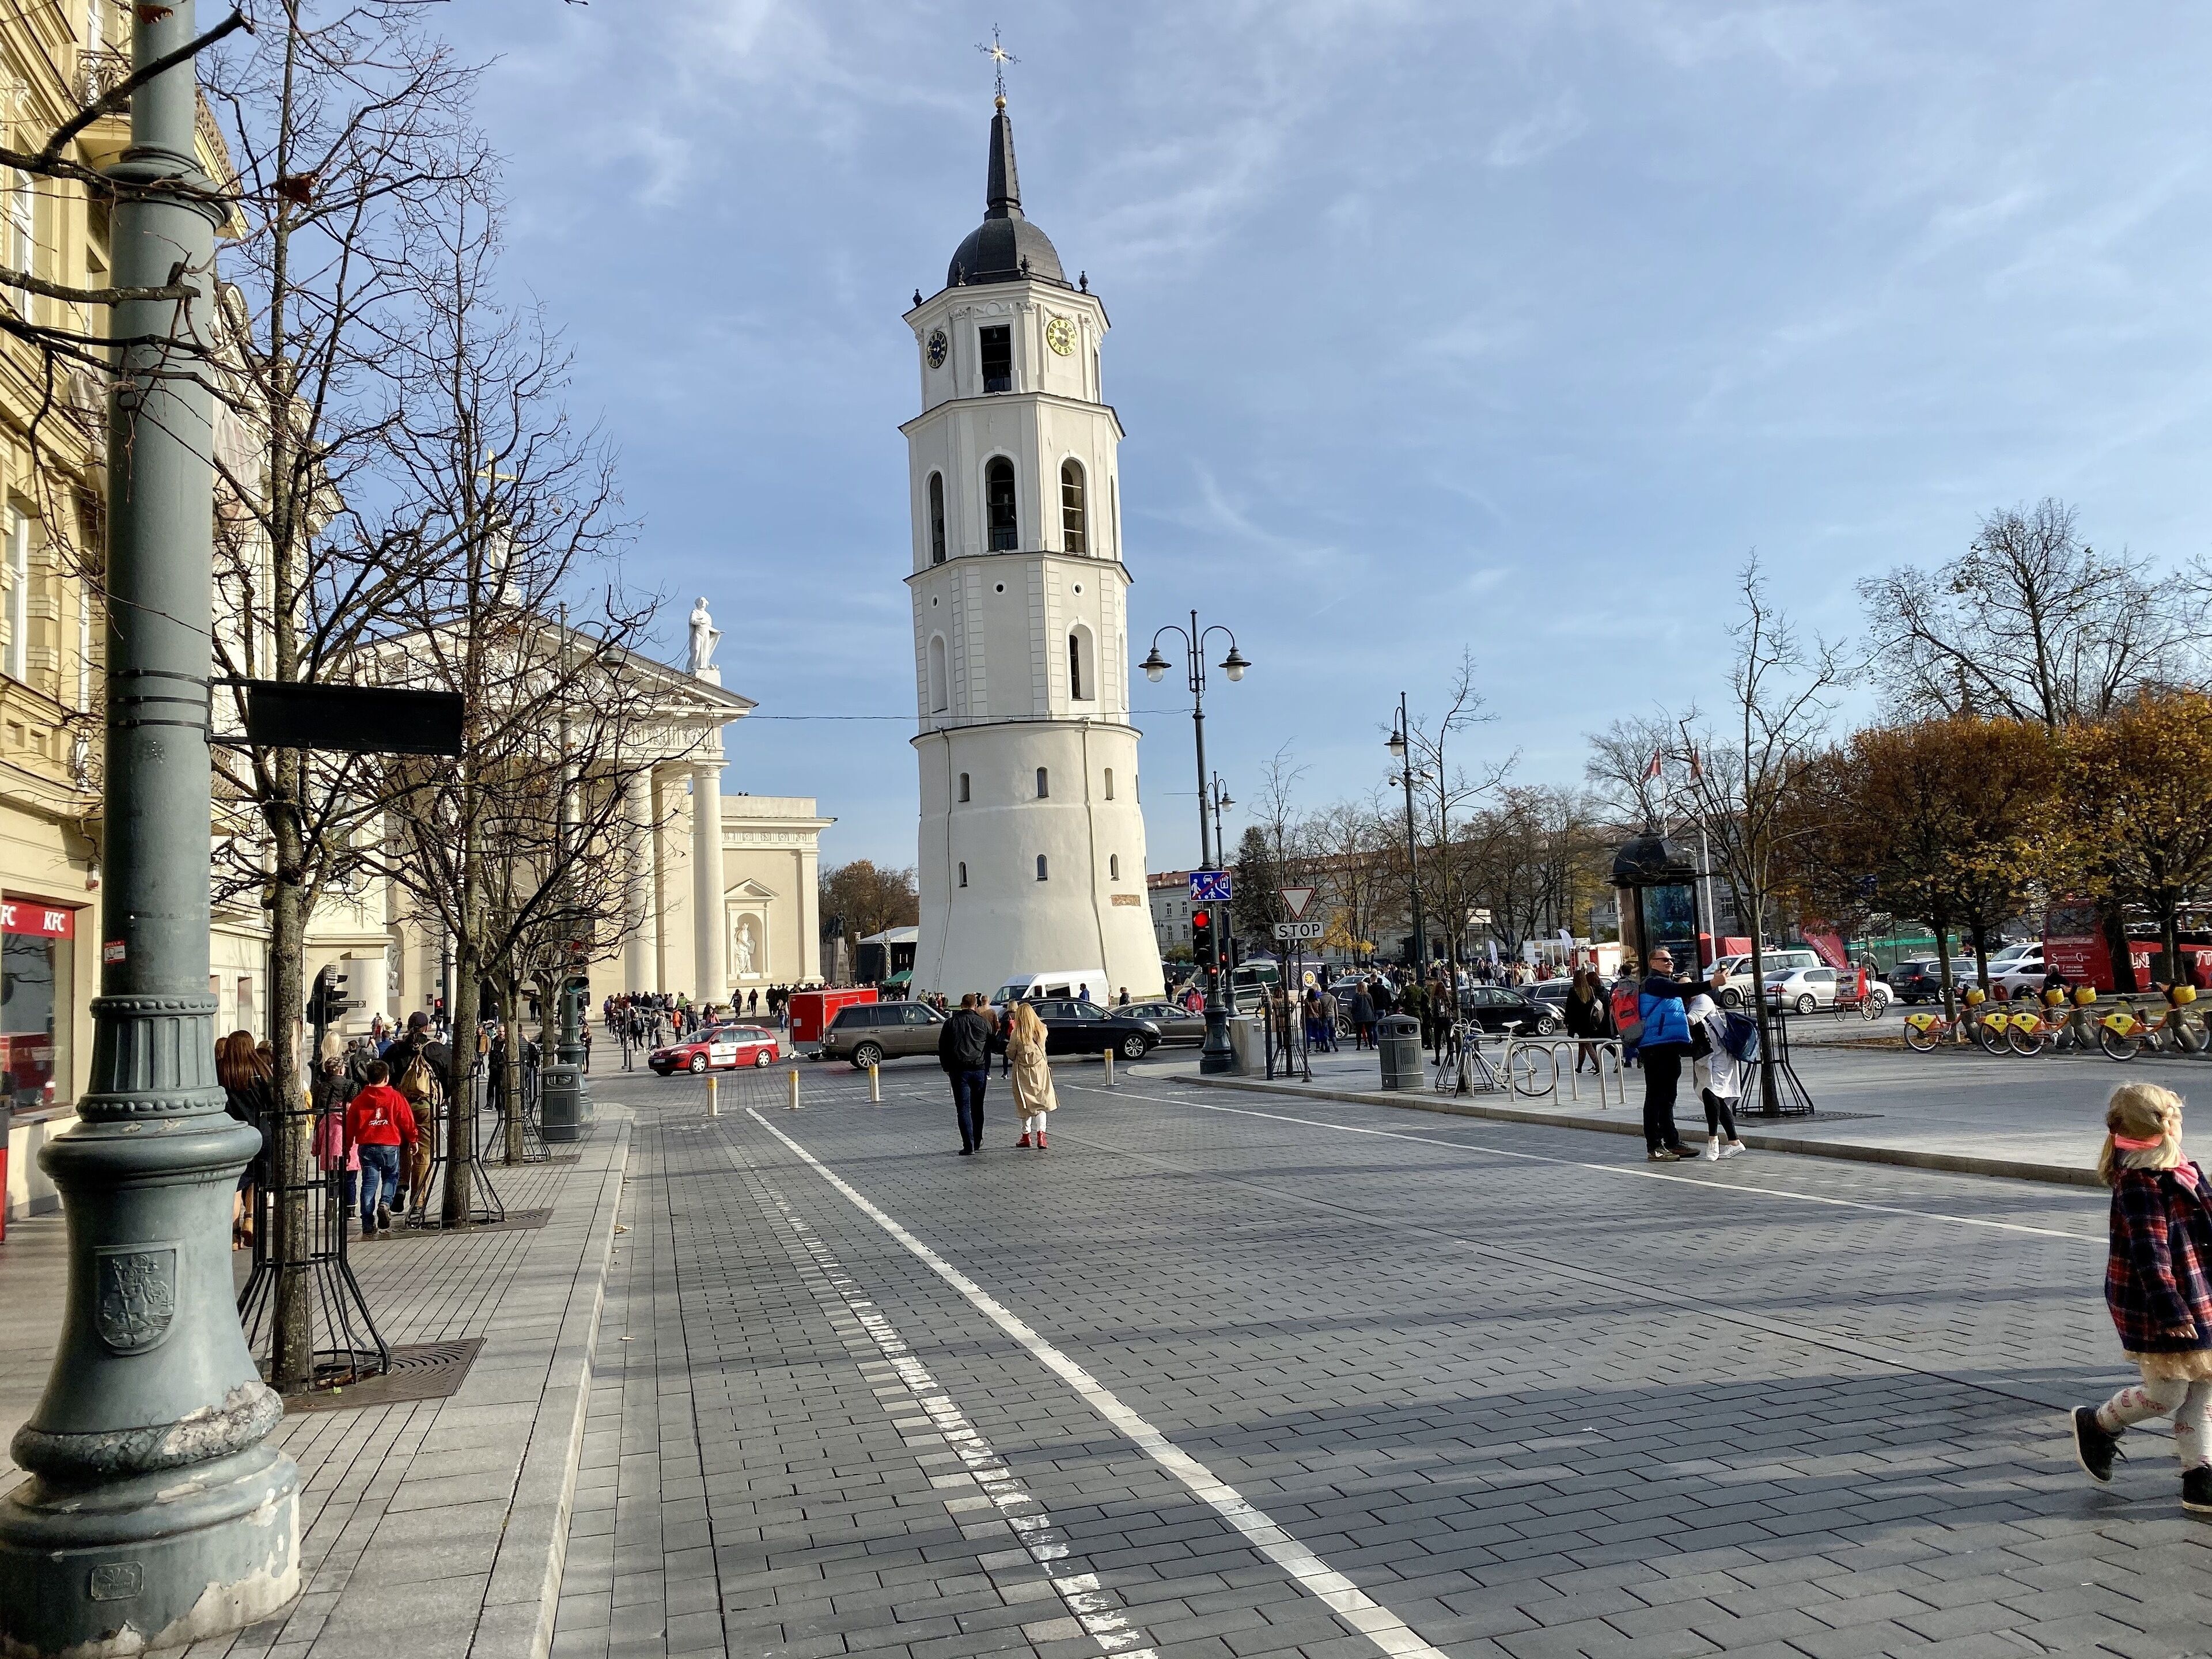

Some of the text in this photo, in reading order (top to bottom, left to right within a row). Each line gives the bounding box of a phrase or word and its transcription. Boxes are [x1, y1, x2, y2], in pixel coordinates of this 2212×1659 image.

[0, 904, 16, 926] FC
[43, 911, 65, 932] KFC
[1279, 924, 1320, 938] STOP
